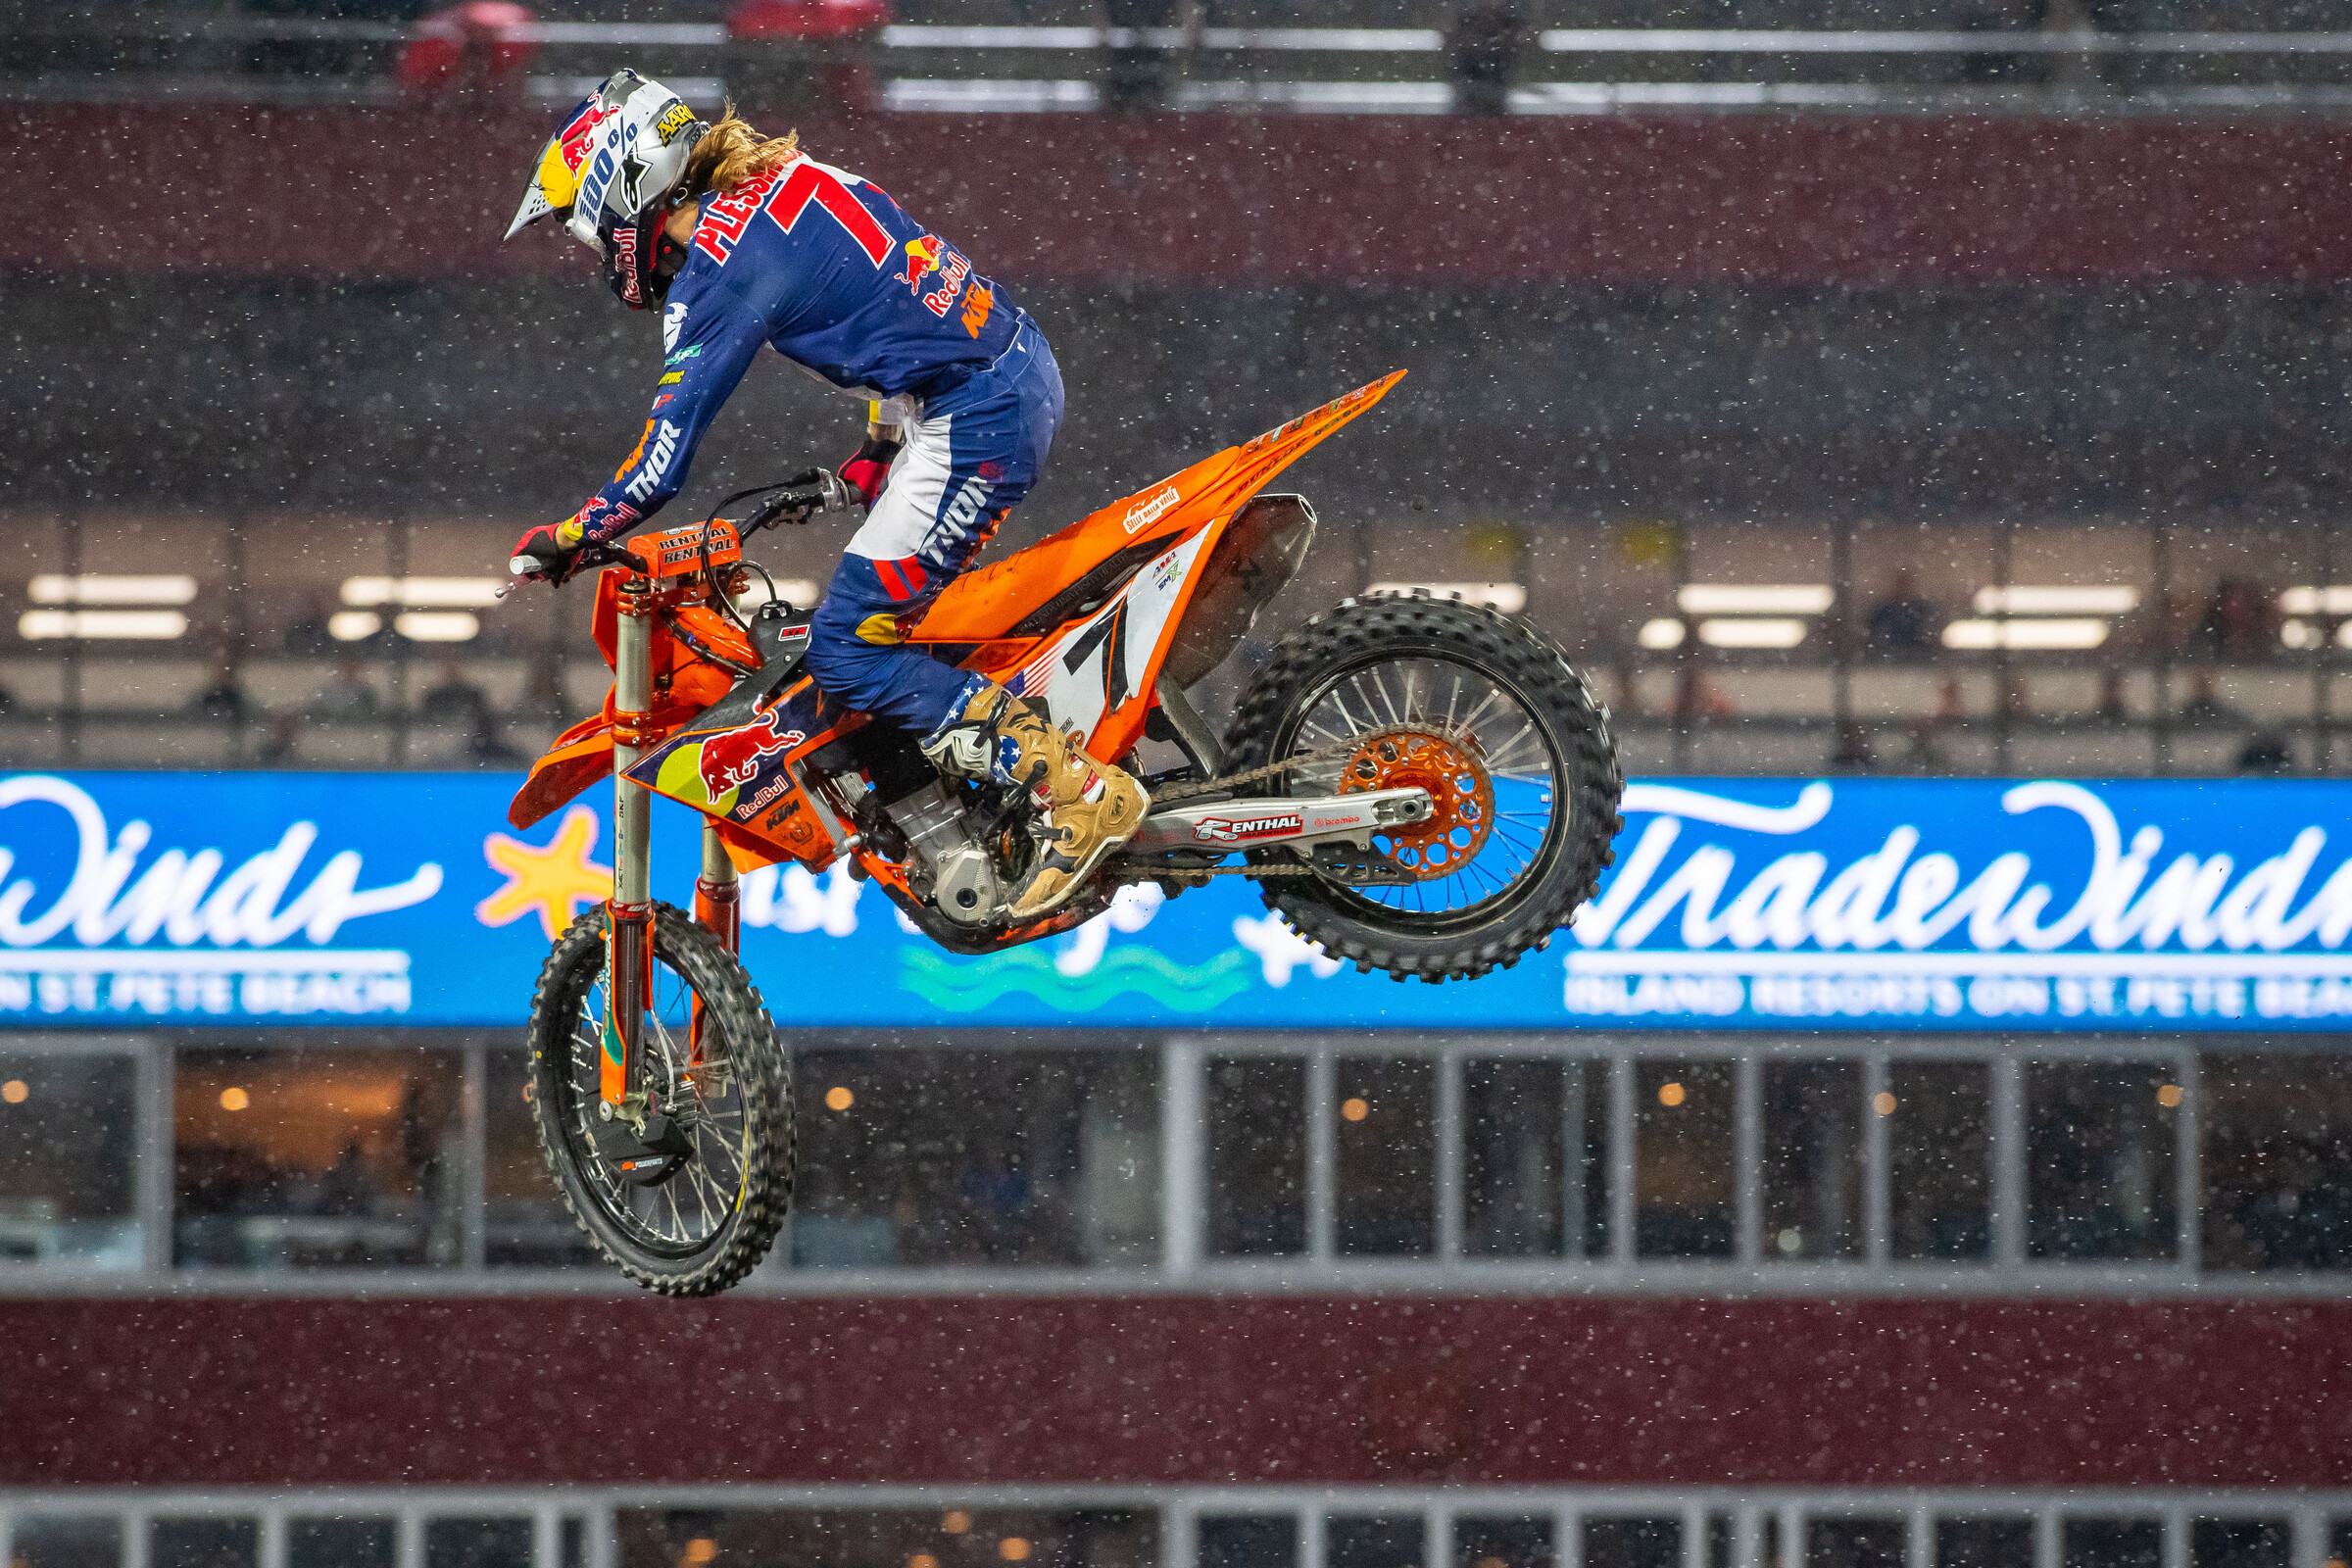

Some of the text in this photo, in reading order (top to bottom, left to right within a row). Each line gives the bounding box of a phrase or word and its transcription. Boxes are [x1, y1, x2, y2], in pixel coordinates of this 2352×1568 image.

[579, 112, 638, 227] 100%
[763, 163, 898, 271] 7
[960, 282, 994, 340] KTM
[624, 418, 681, 504] THOR
[659, 526, 731, 550] RENTAL
[917, 475, 997, 566] THOR
[1125, 514, 1144, 531] SELLE
[1143, 503, 1160, 518] DALLA
[1159, 490, 1176, 506] VALLE
[1062, 594, 1129, 716] 7
[765, 799, 802, 832] KTM
[1325, 815, 1360, 826] brembo
[1572, 780, 2352, 951] TradeWind
[239, 972, 412, 1014] BEACH
[1564, 974, 1745, 1017] ISLAND
[1750, 975, 1962, 1017] RESORTS
[1967, 975, 2051, 1017] ON
[2127, 975, 2248, 1018] PETE
